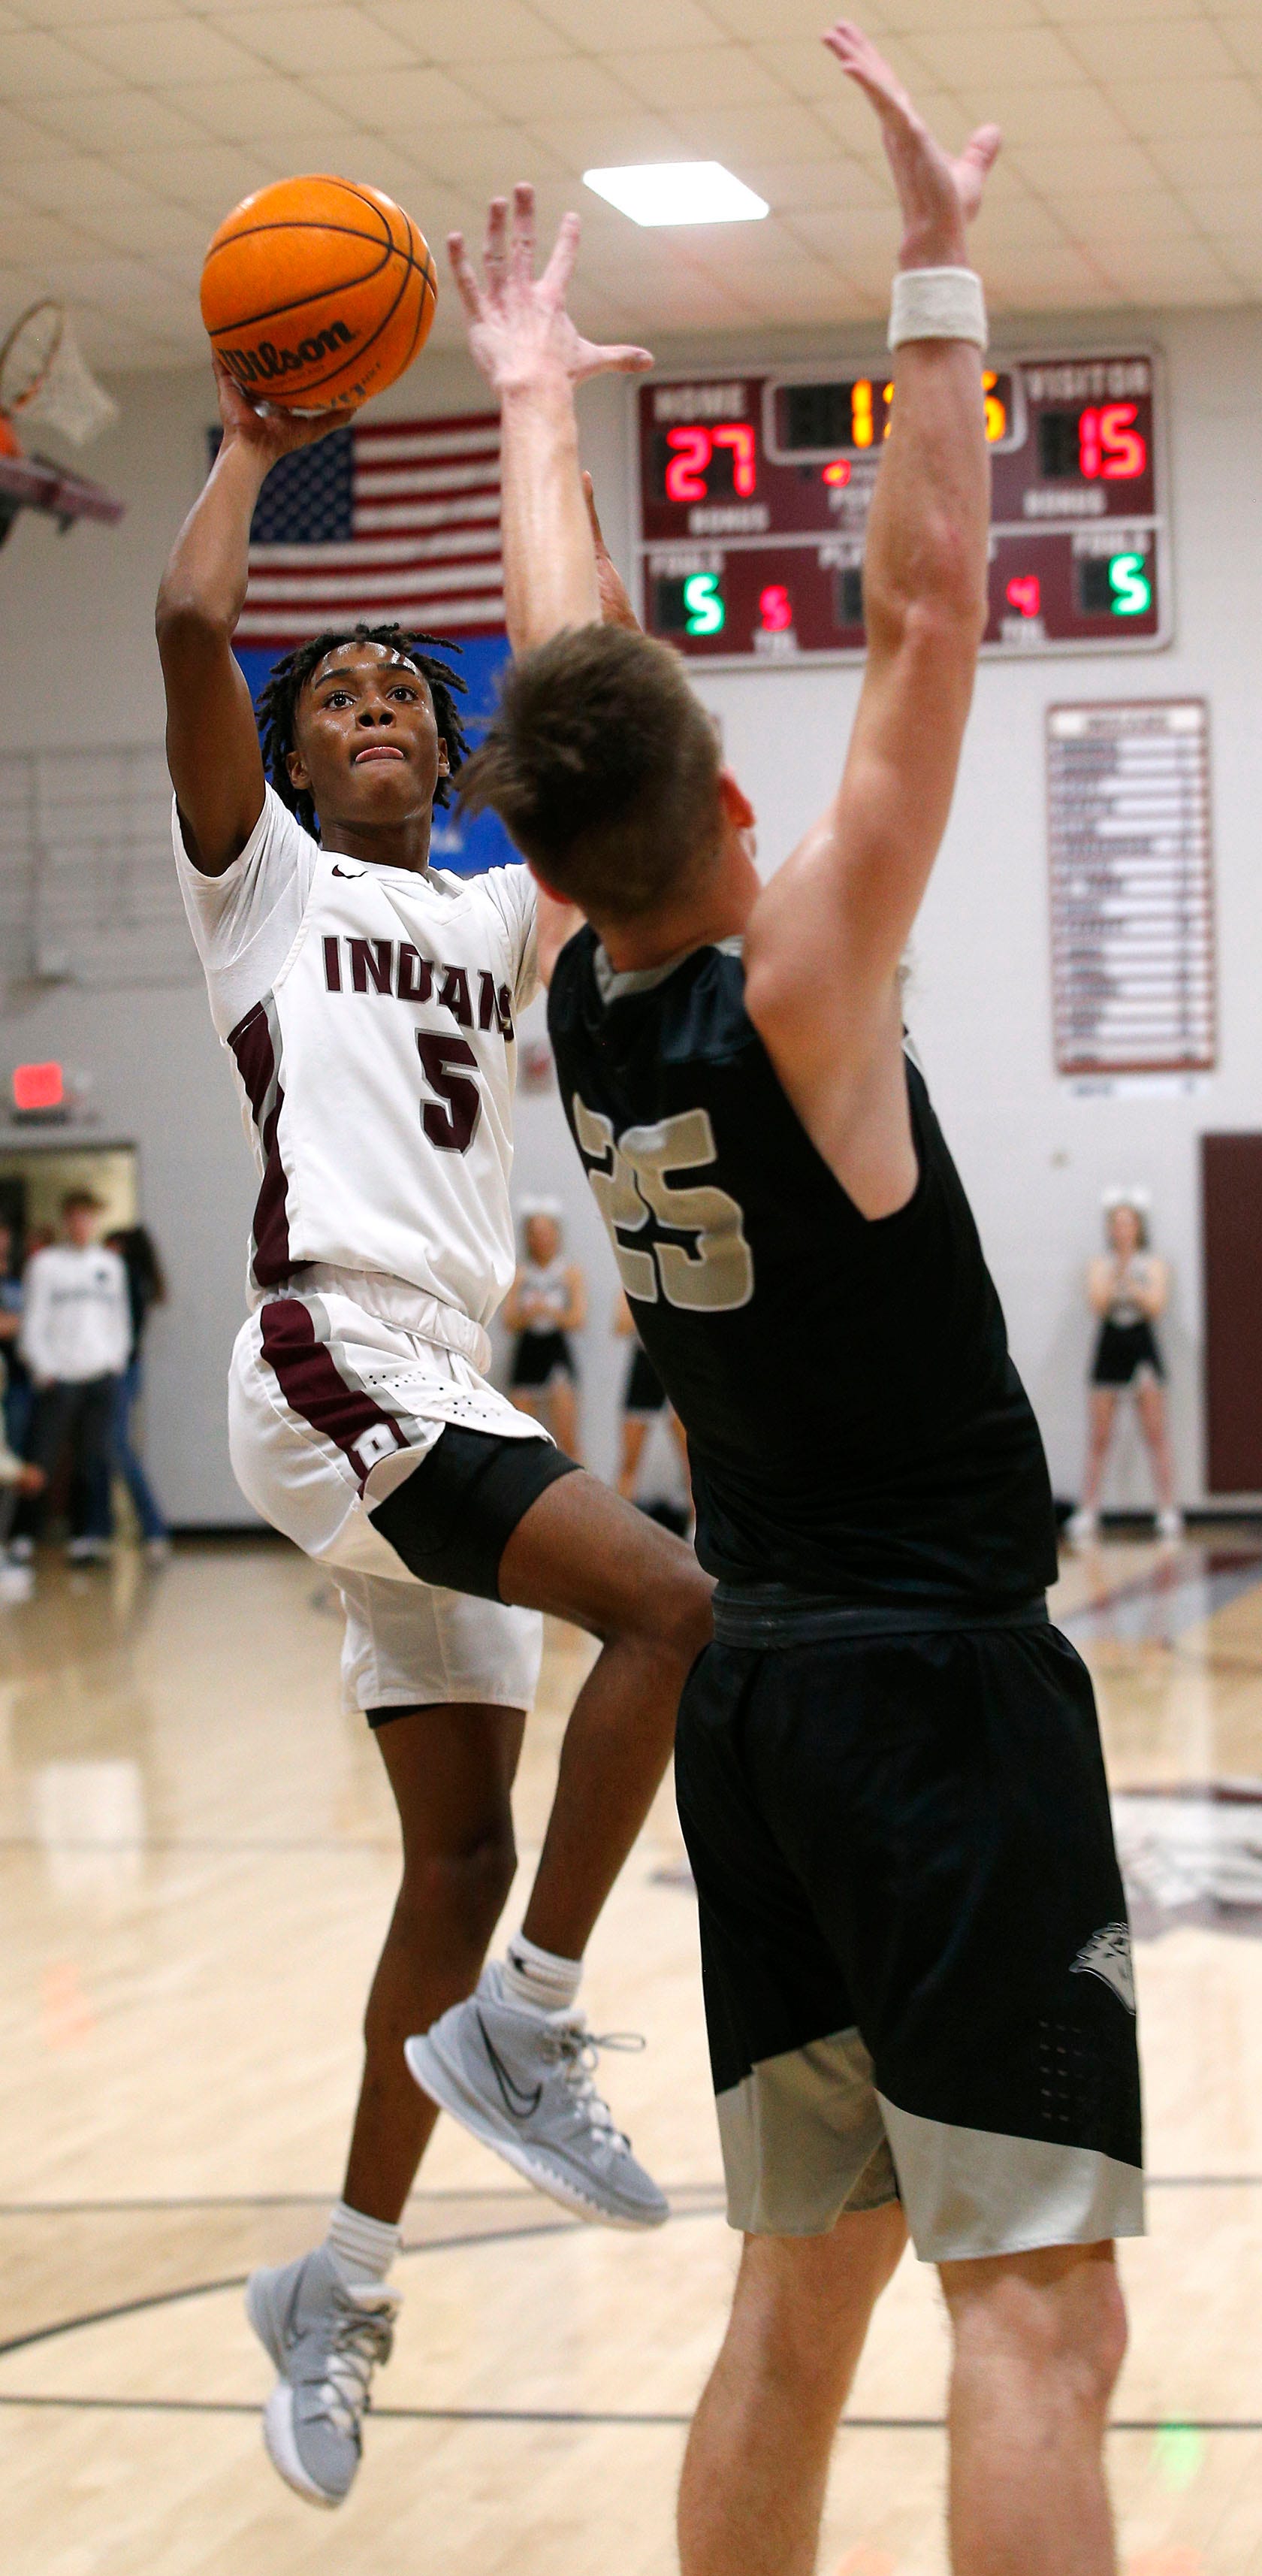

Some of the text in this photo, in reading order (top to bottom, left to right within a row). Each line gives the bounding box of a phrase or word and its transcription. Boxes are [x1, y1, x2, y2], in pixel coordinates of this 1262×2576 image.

[218, 321, 356, 382] Wilson
[666, 426, 756, 502] 27
[1079, 402, 1146, 479] 15
[684, 572, 726, 636] 5
[759, 584, 793, 632] 5
[1108, 552, 1152, 616] 5
[415, 1027, 482, 1158] 5
[572, 1091, 754, 1312] 25
